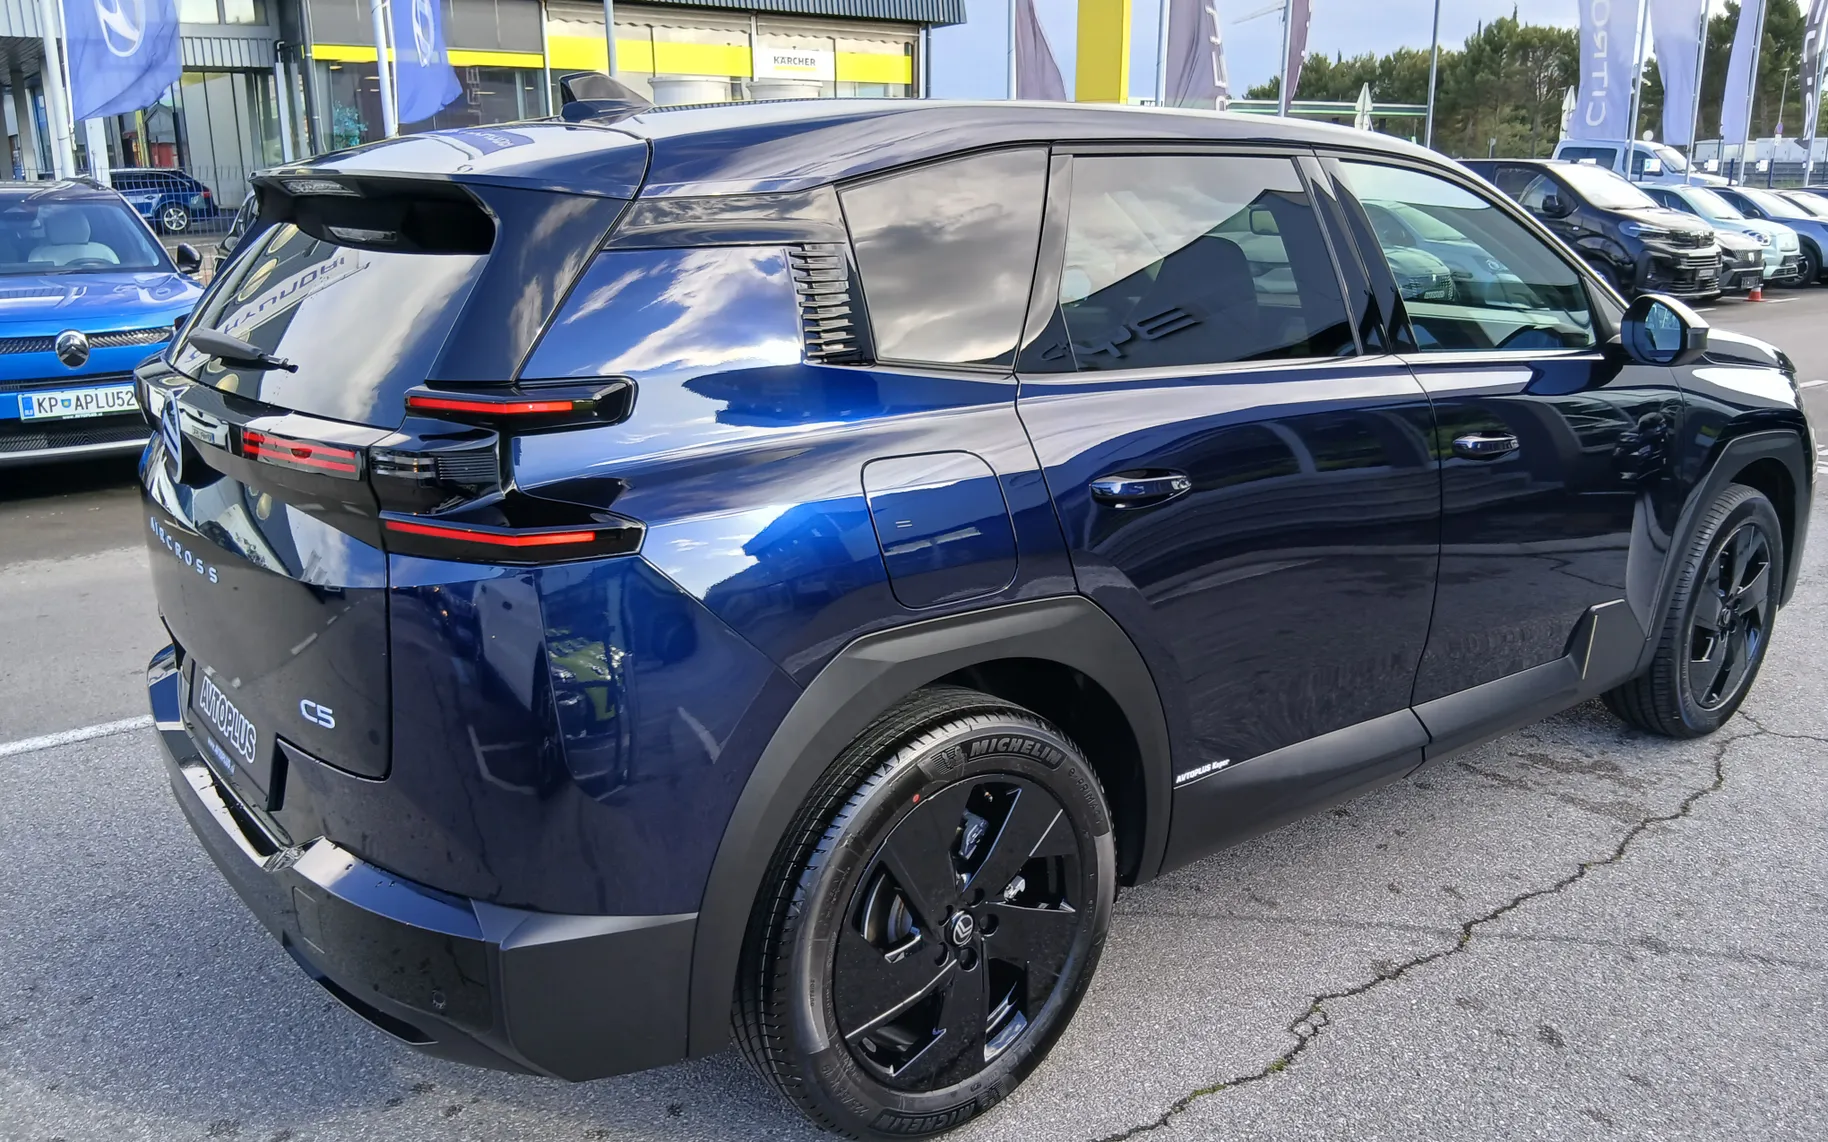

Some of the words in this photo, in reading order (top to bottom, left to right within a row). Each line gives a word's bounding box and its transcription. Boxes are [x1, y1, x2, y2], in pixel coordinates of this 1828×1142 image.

[773, 56, 816, 66] KÄRCHER
[37, 397, 59, 413] KP
[74, 390, 136, 411] APLU52
[150, 516, 218, 584] AIRCROSS
[200, 675, 257, 764] AVTOPLUS
[300, 699, 336, 729] C5
[969, 737, 1063, 765] MICHELIN
[1176, 764, 1212, 784] AVTOPLUS
[876, 1100, 976, 1133] MICHELIN
